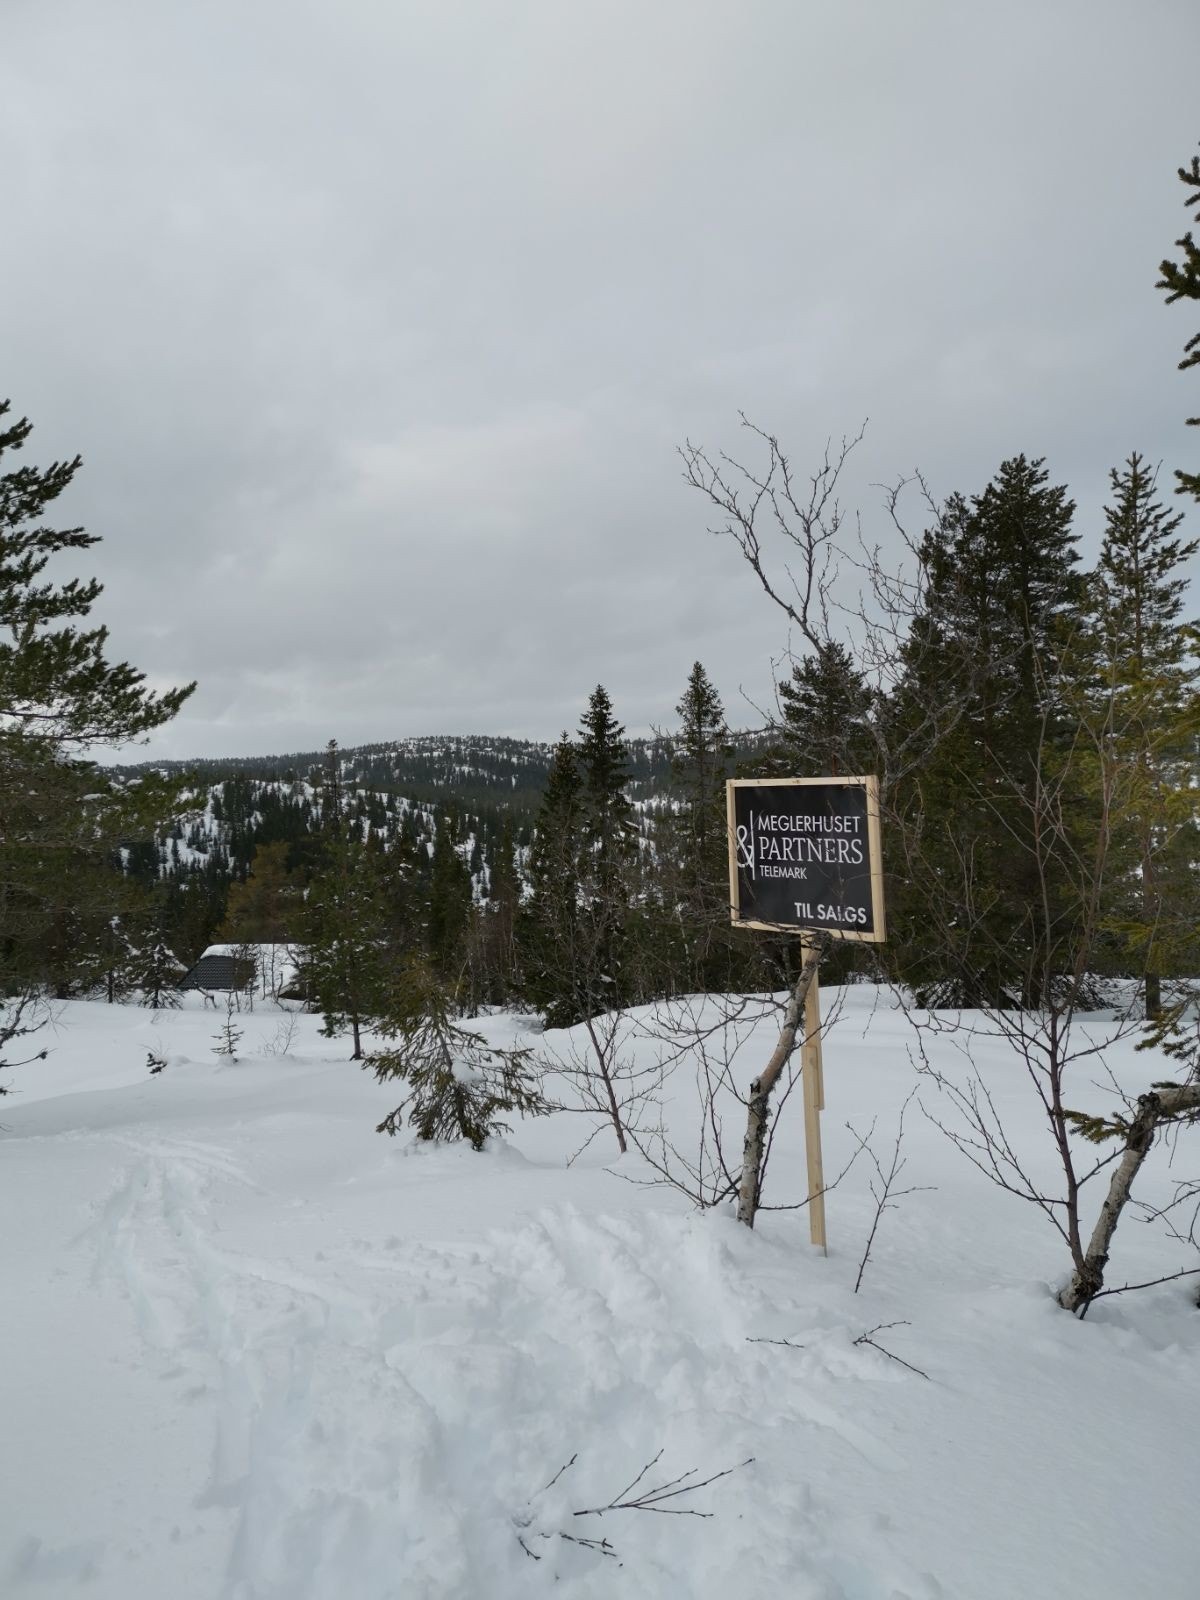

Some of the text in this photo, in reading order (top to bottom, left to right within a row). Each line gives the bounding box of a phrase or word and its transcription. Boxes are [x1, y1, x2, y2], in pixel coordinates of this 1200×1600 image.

[758, 815, 861, 833] MEGLERHUSET
[758, 836, 863, 864] PARTNERS
[759, 865, 807, 879] TELEMARK
[794, 902, 867, 924] TIL SALGS
